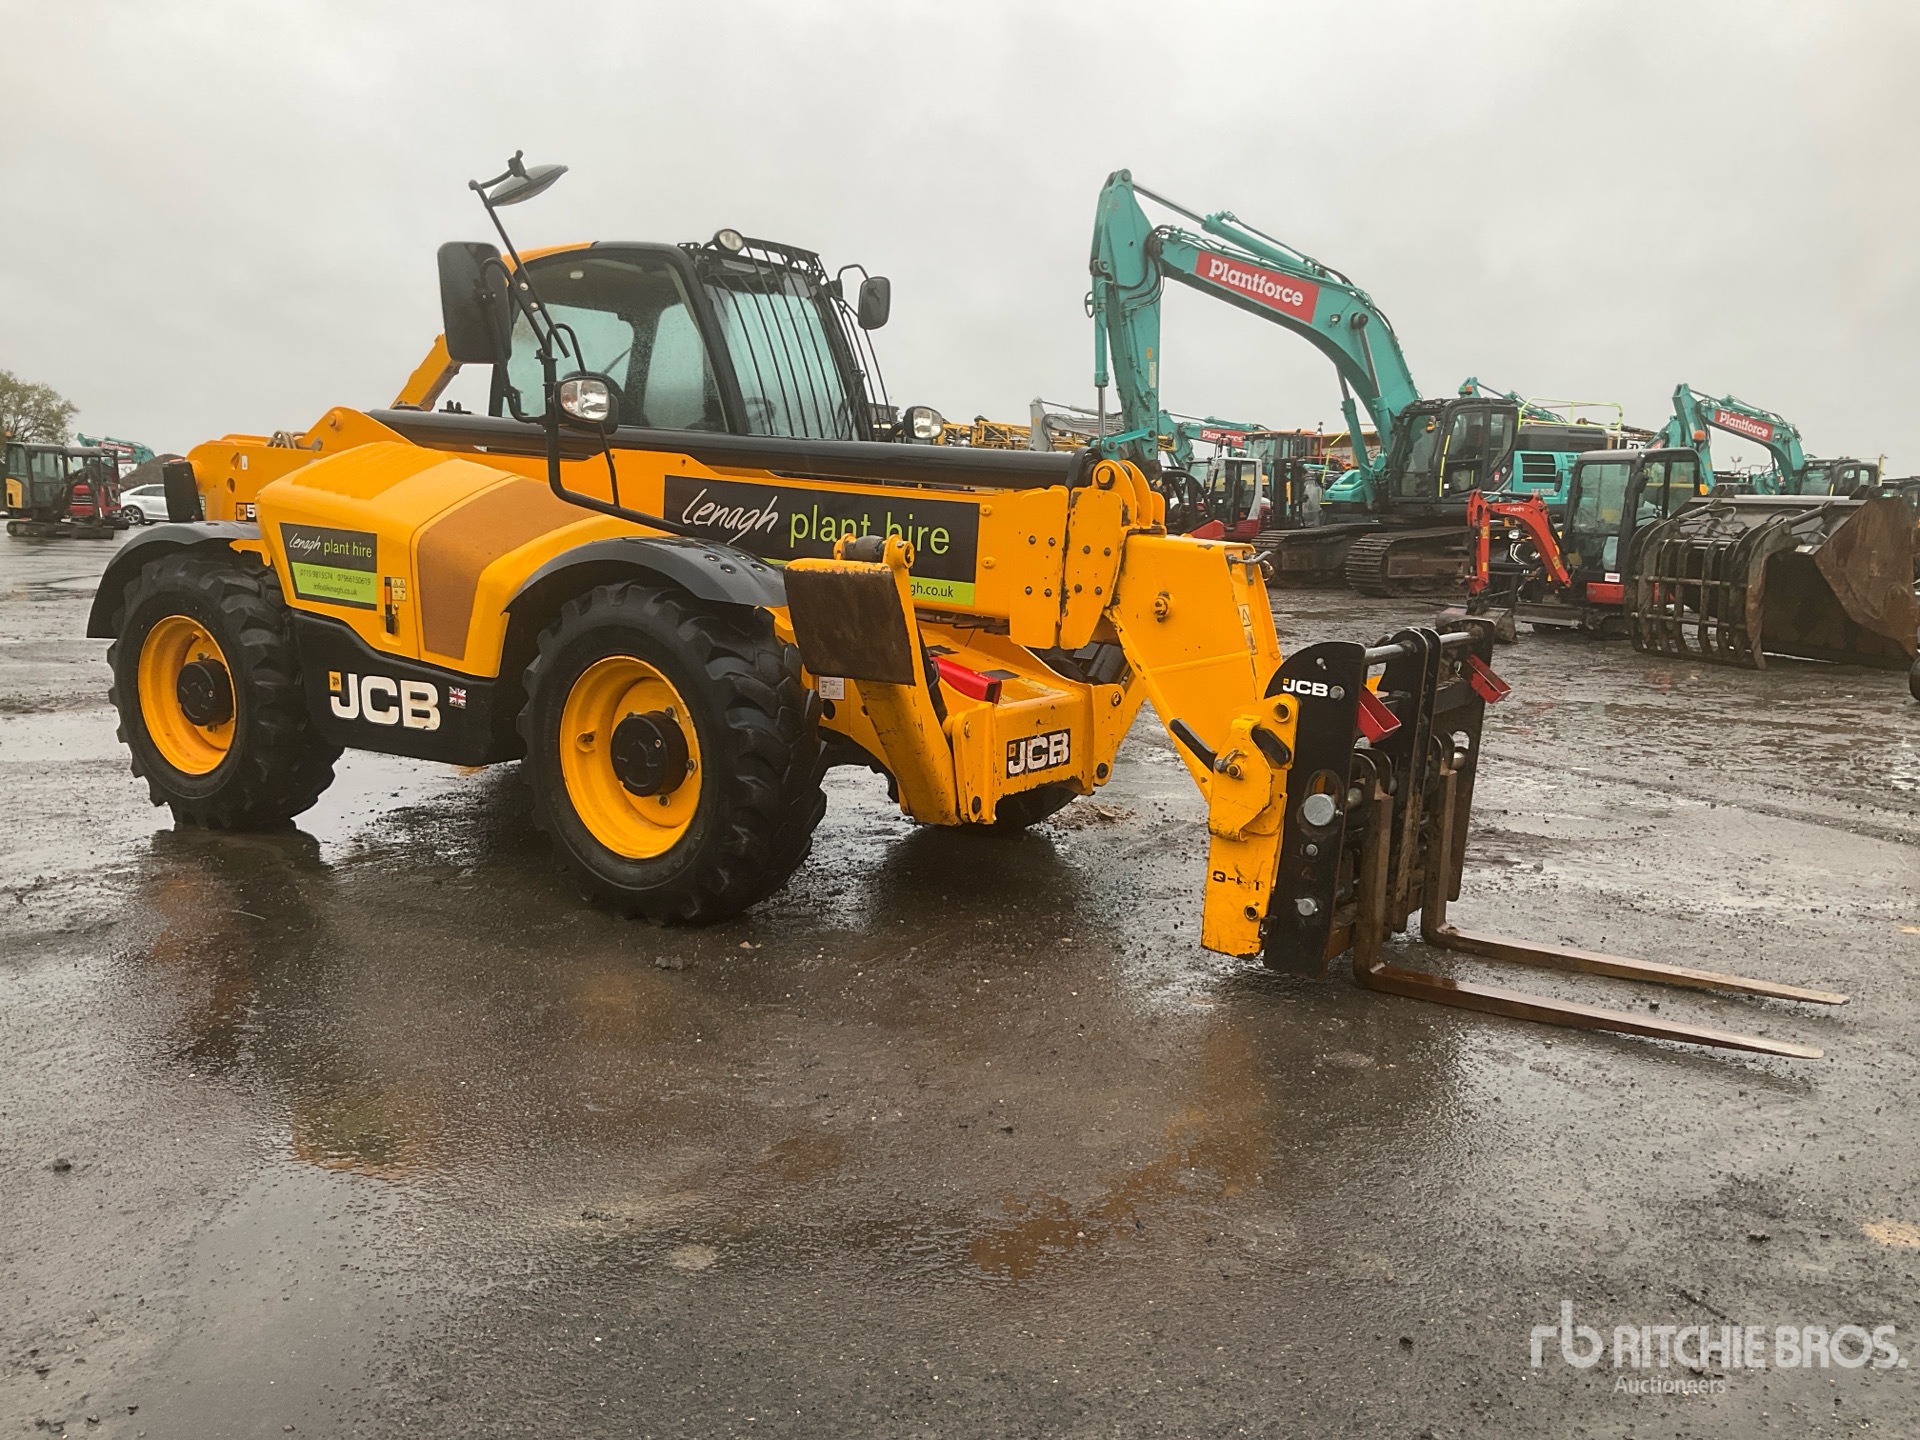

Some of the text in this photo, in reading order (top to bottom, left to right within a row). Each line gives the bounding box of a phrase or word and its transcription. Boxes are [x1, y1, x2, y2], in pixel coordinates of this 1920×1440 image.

[1208, 258, 1304, 307] Plantforce
[1719, 411, 1769, 438] Plantforce
[324, 538, 350, 557] plant
[352, 541, 373, 558] hire
[790, 504, 871, 549] plant
[886, 511, 950, 555] hire
[330, 672, 441, 731] JCB
[1282, 679, 1329, 697] JCB
[1007, 732, 1070, 775] JCB
